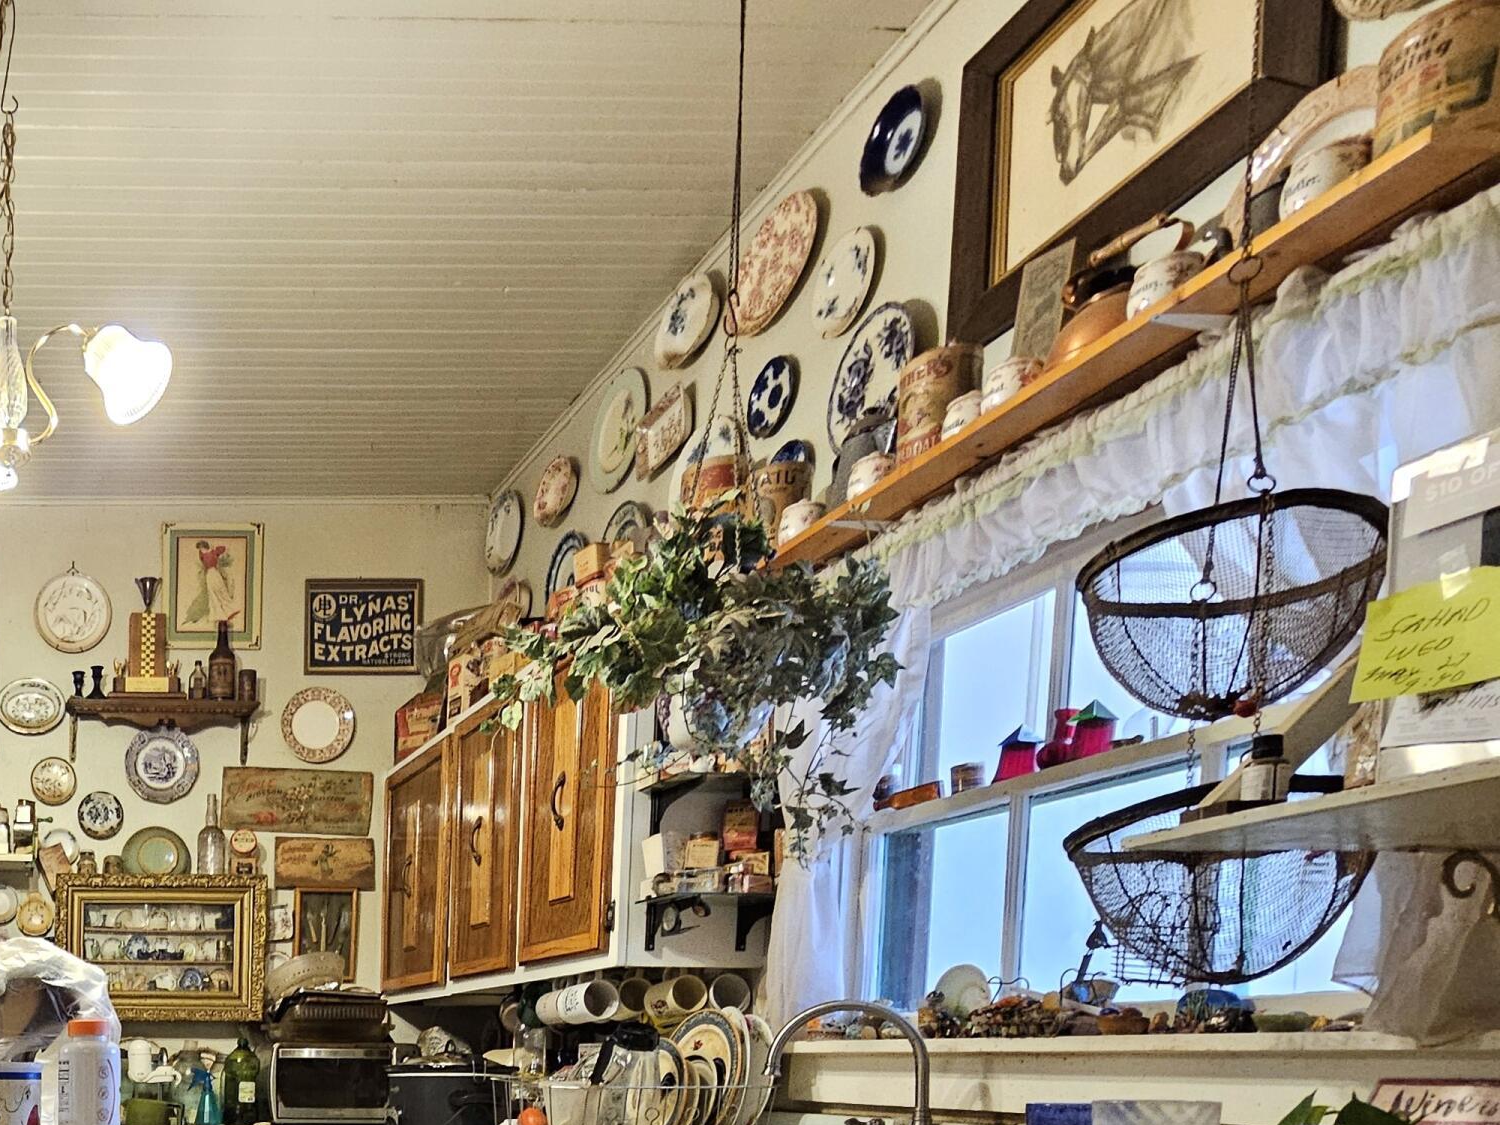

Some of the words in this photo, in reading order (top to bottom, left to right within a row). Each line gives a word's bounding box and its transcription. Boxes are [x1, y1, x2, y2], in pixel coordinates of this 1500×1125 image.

[339, 594, 362, 604] DR.
[313, 613, 412, 643] FLAVORING
[314, 633, 413, 662] EXTRACTS
